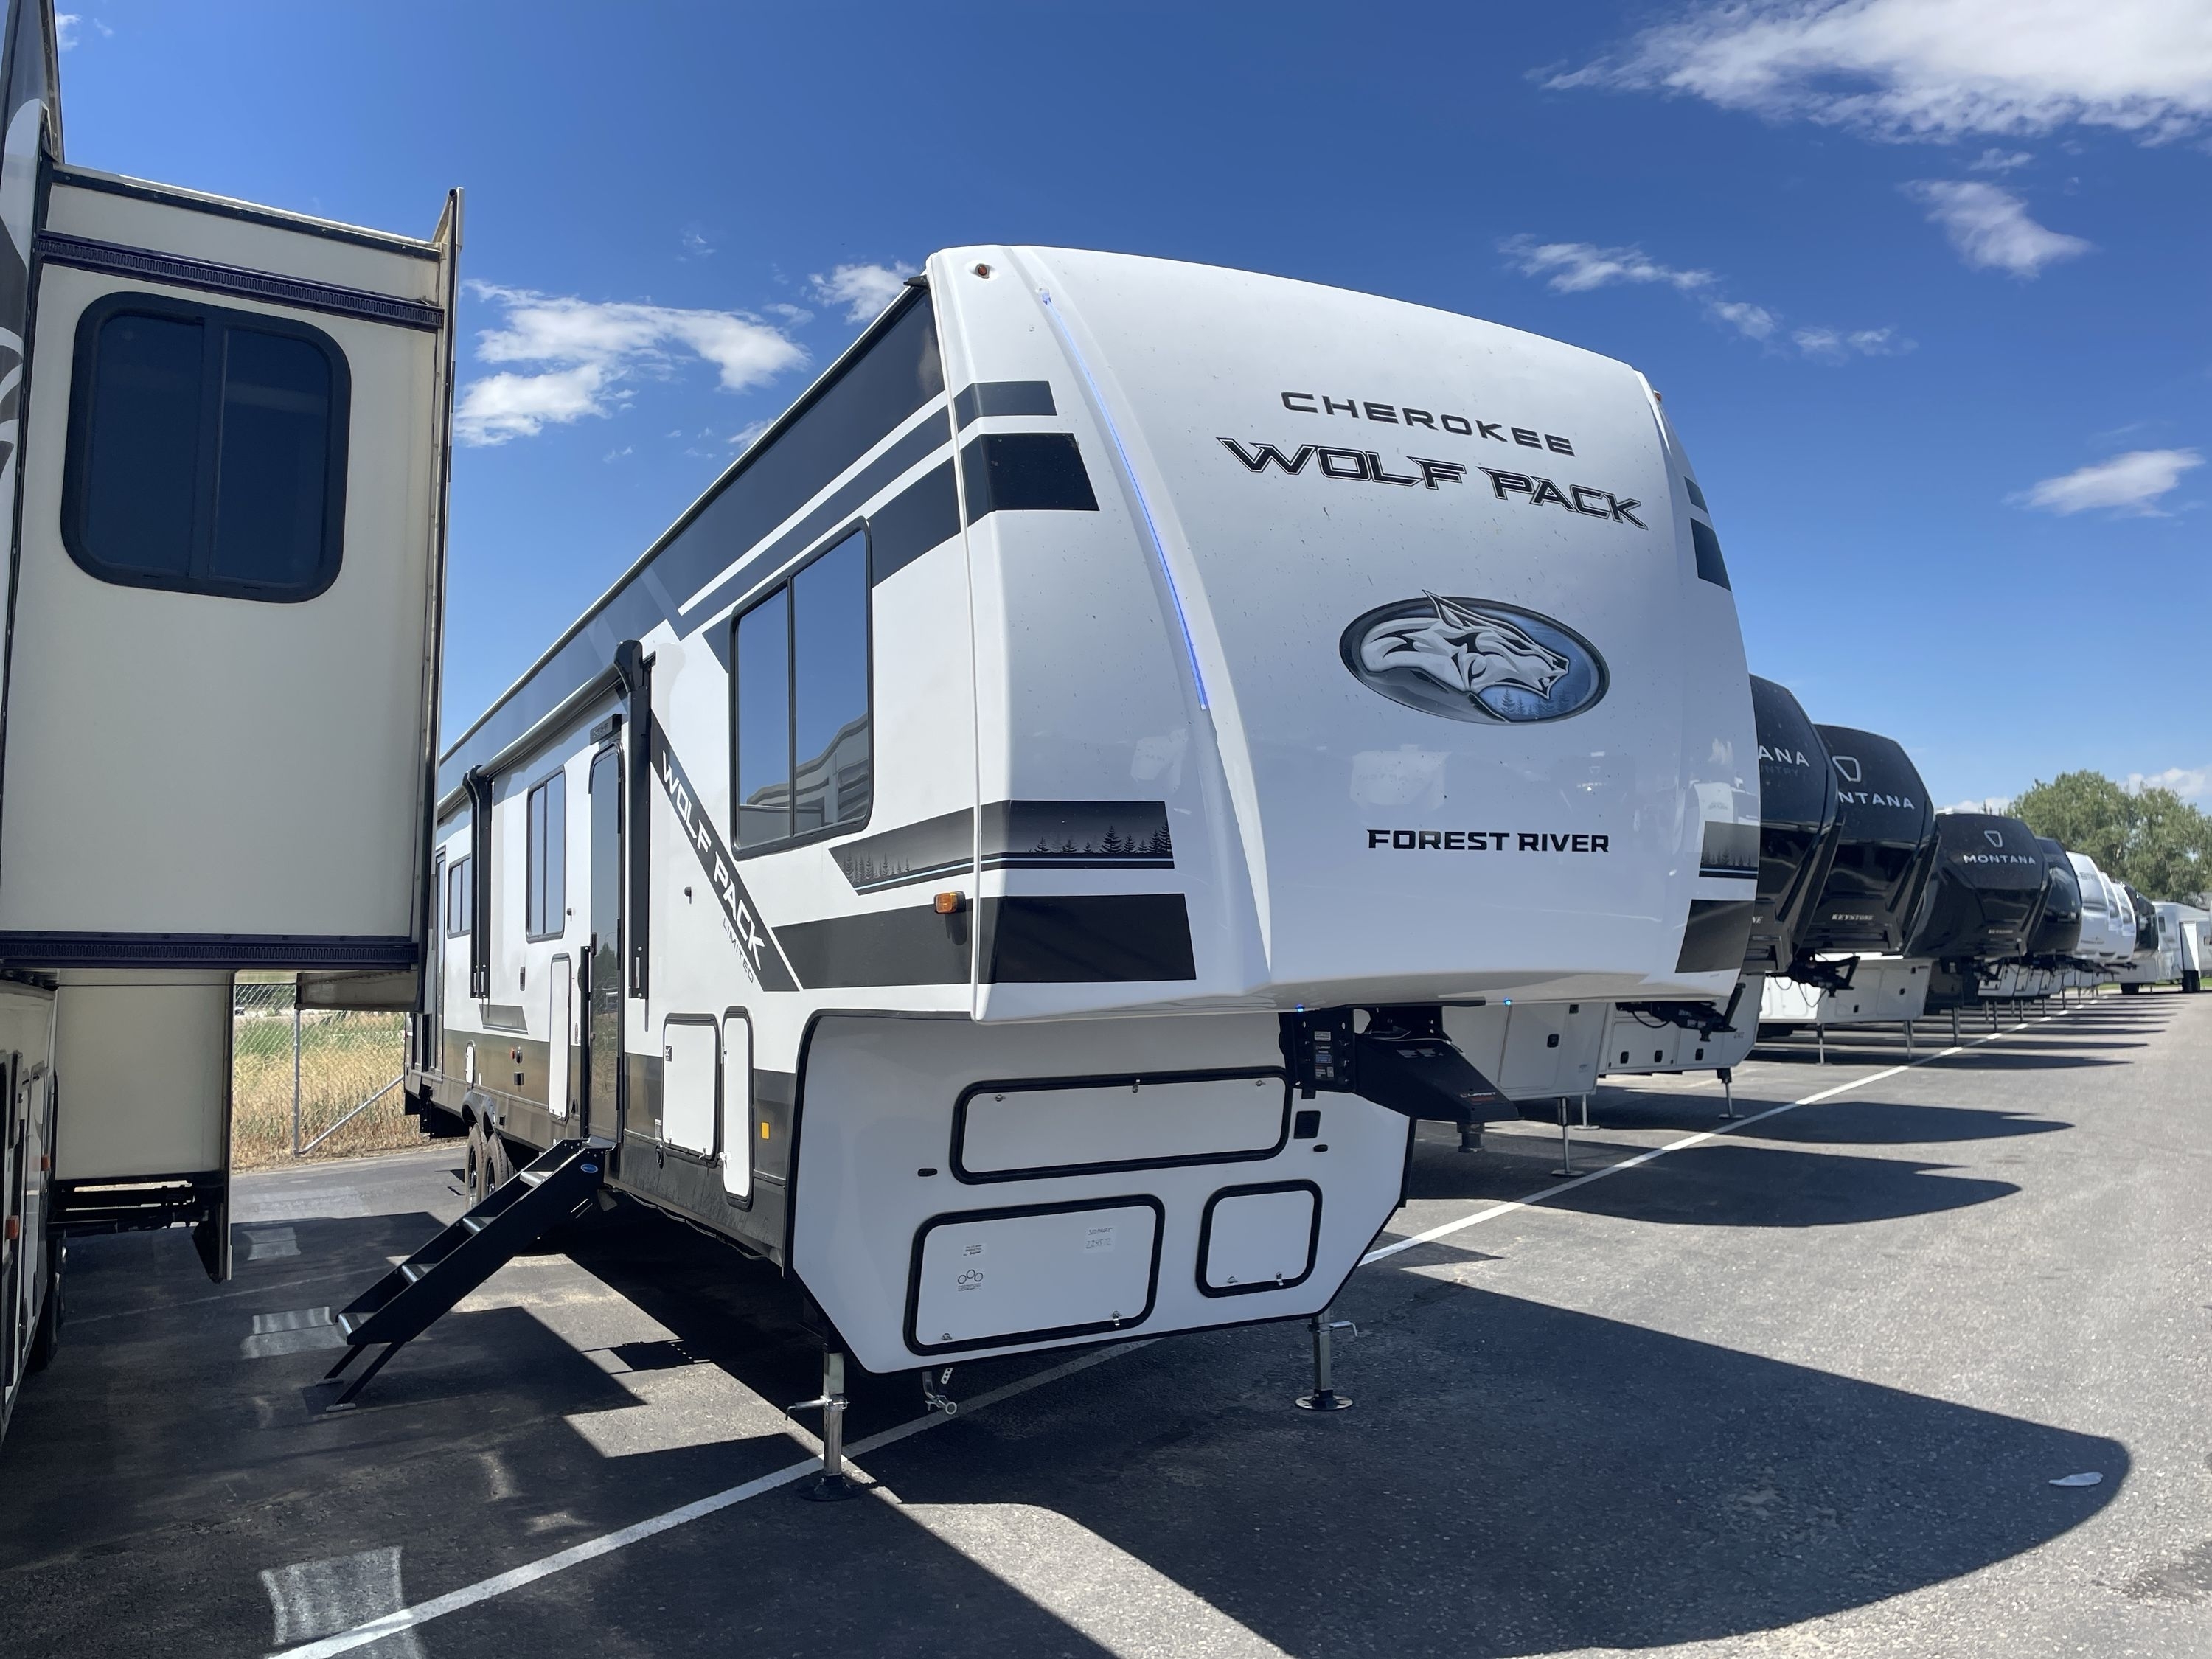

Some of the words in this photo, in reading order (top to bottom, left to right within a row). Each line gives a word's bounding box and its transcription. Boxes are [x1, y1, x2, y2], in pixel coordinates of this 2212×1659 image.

[1281, 390, 1576, 456] CHEROKEE
[1216, 437, 1467, 490] WOLF
[1475, 465, 1649, 530] PACK
[662, 749, 712, 852] WOLF
[713, 850, 765, 971] PACK
[1366, 829, 1511, 851] FOREST
[1517, 832, 1610, 852] RIVER
[1963, 855, 2036, 865] MONTANA
[723, 917, 754, 984] LIMITED
